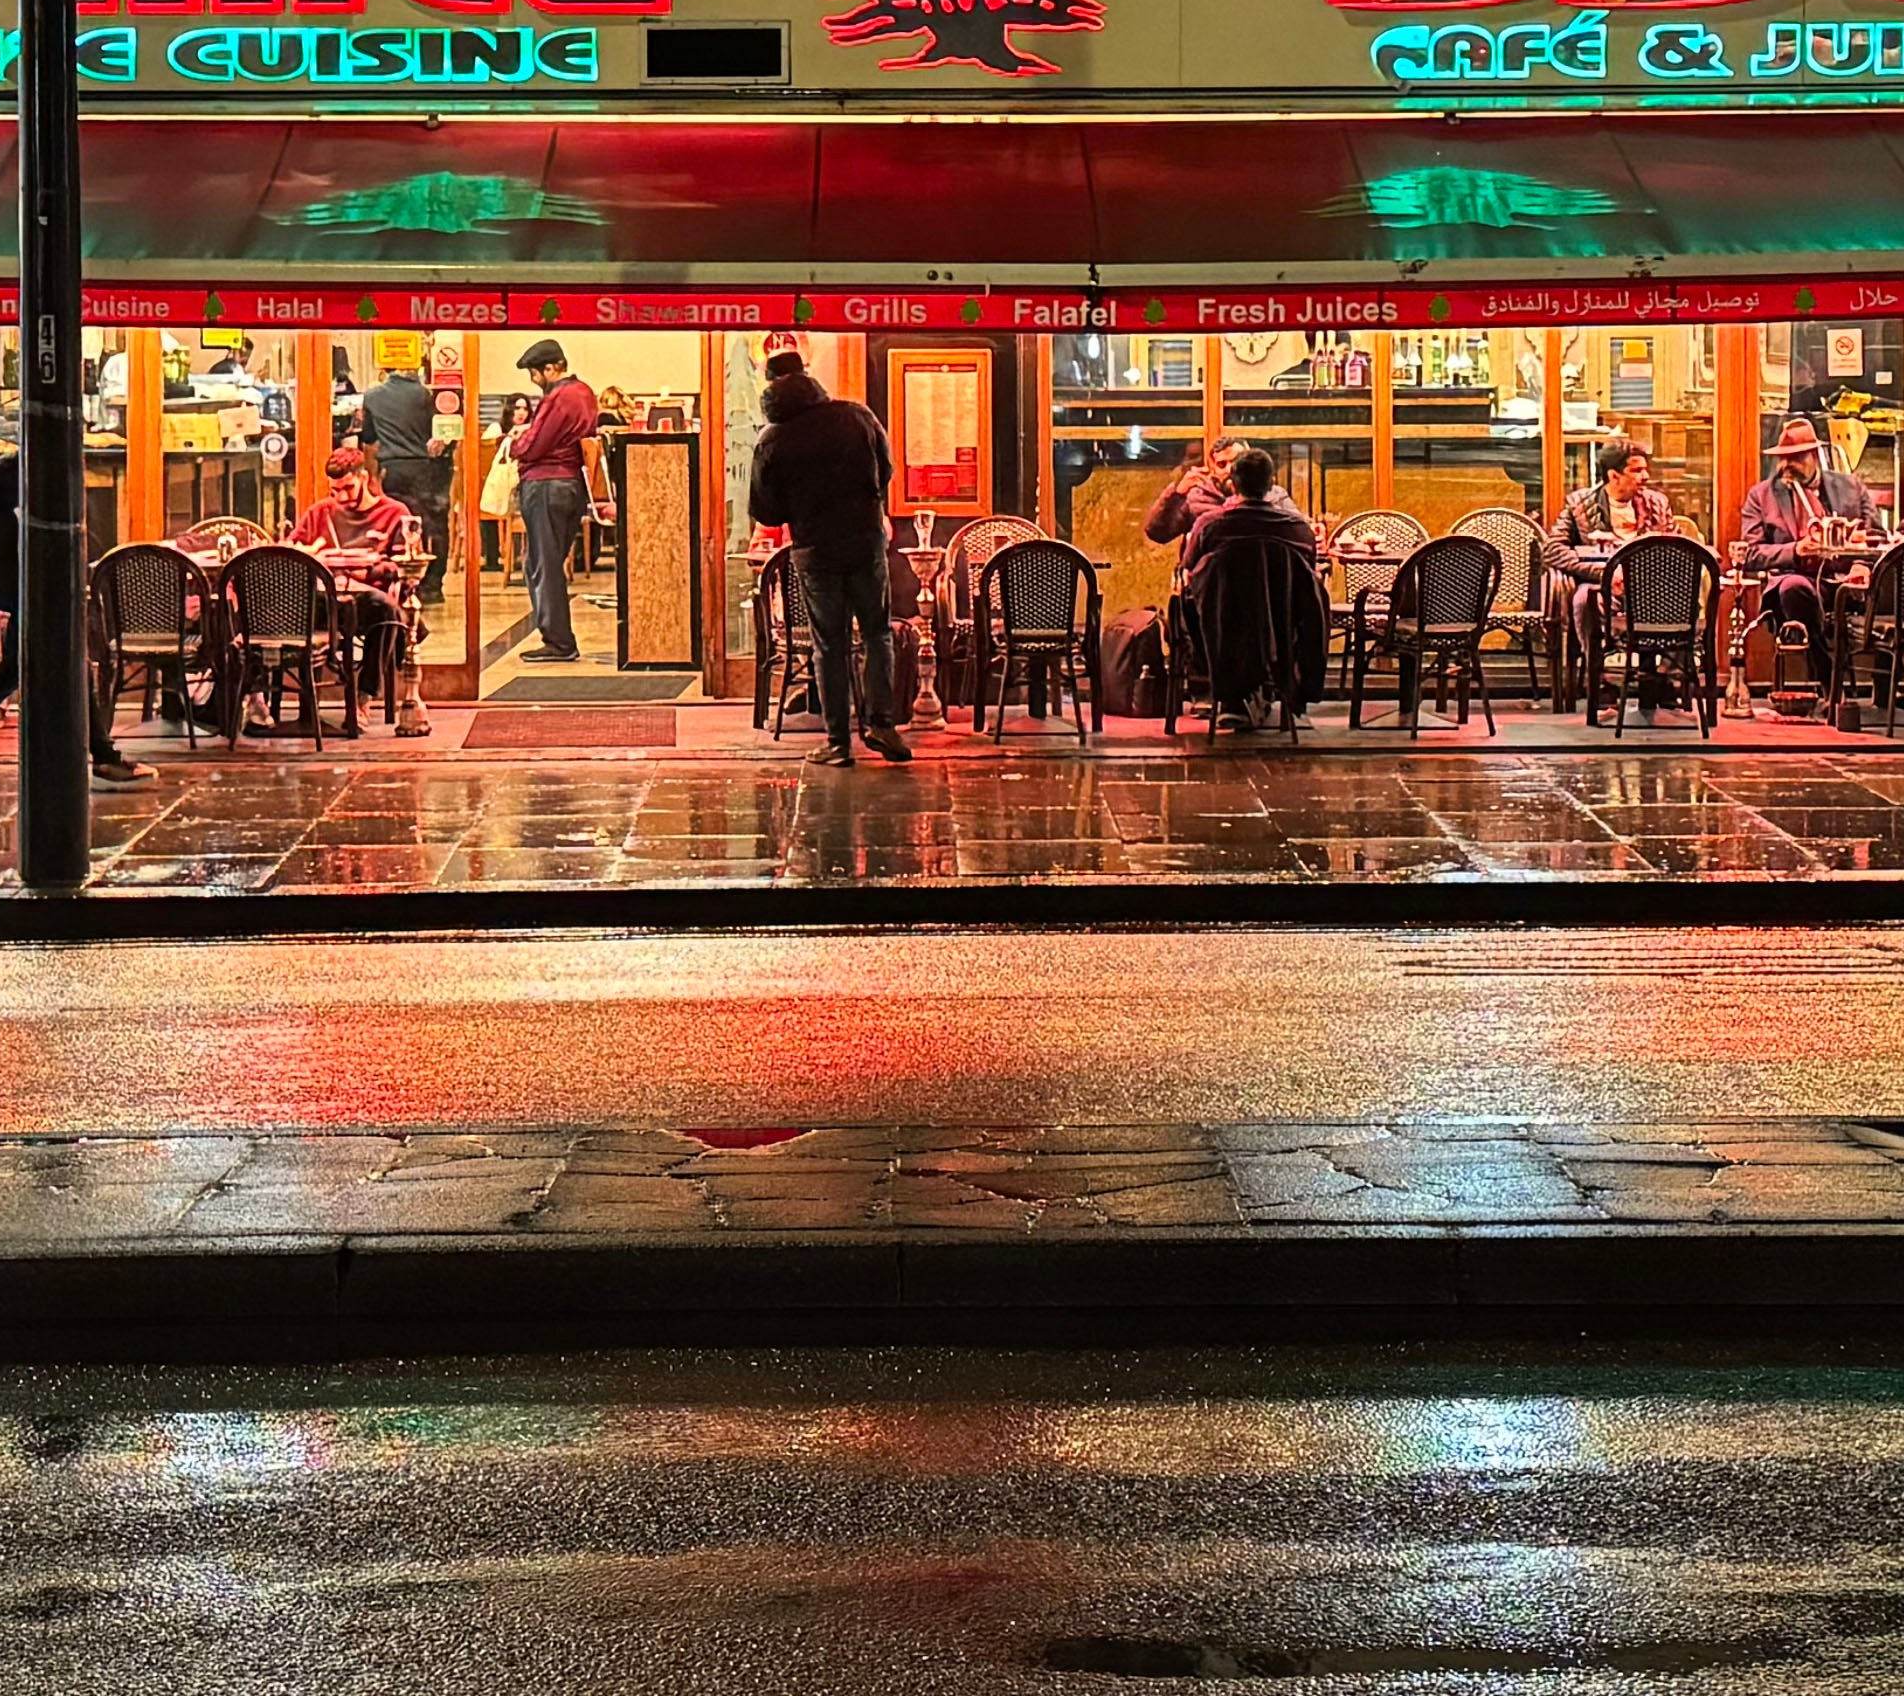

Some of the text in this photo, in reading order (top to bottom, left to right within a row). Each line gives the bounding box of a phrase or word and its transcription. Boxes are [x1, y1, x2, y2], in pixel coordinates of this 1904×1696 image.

[167, 25, 599, 83] CUISINE
[1370, 9, 1610, 84] CAFÉ
[1638, 25, 1734, 77] &
[257, 297, 323, 321] Halal
[410, 297, 507, 323] Mezes
[596, 297, 761, 324] Shawarma
[844, 297, 927, 324] Grills
[1014, 298, 1117, 326] Falafel
[1198, 296, 1399, 324] Fresh Juices
[1634, 291, 1690, 318] مجاني
[1697, 291, 1760, 313] توصيل
[1850, 287, 1898, 311] حلال
